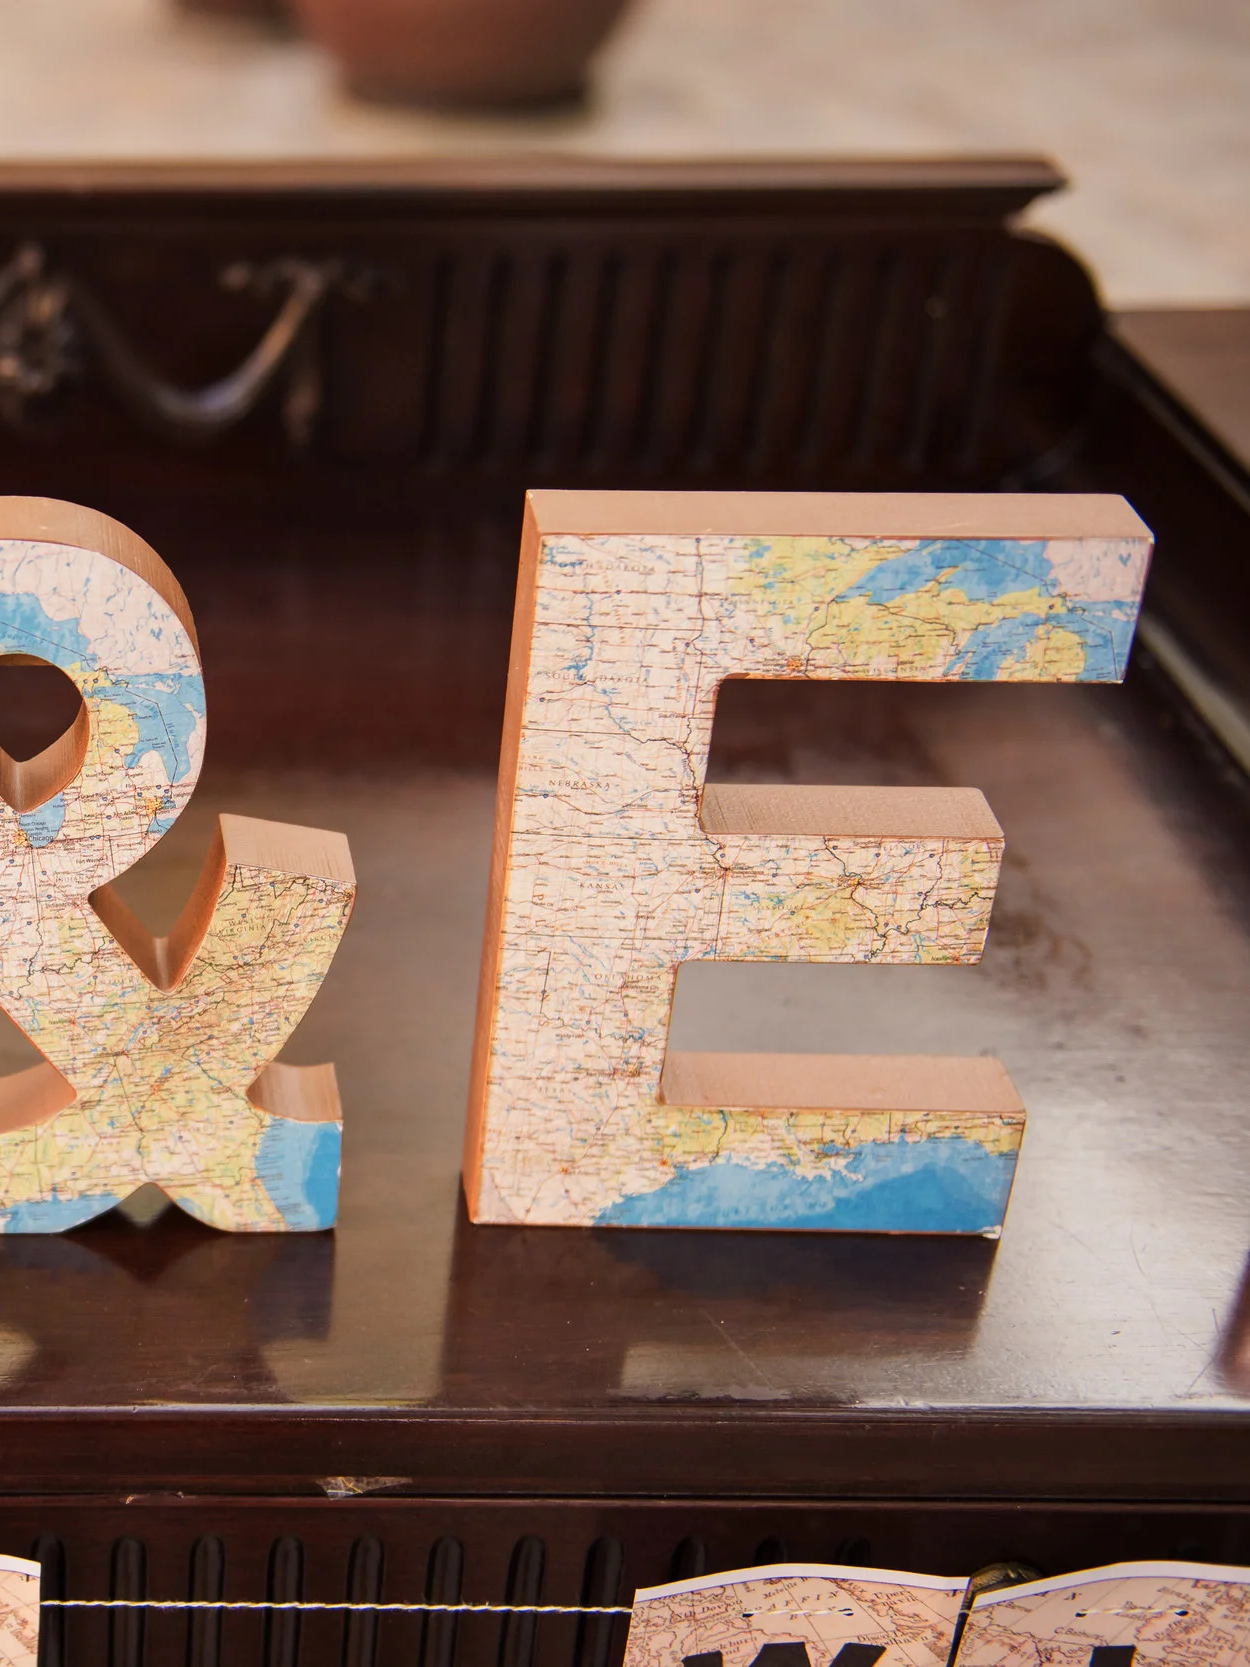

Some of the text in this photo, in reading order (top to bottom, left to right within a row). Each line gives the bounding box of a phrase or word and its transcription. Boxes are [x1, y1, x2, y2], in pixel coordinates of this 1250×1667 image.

[606, 562, 656, 572] DAKOTA
[599, 674, 648, 683] DAKOTA
[548, 779, 611, 789] NEBRASKA
[463, 488, 1155, 1240] E
[579, 882, 625, 890] KANSAS
[594, 973, 662, 981] OKLAHOMA
